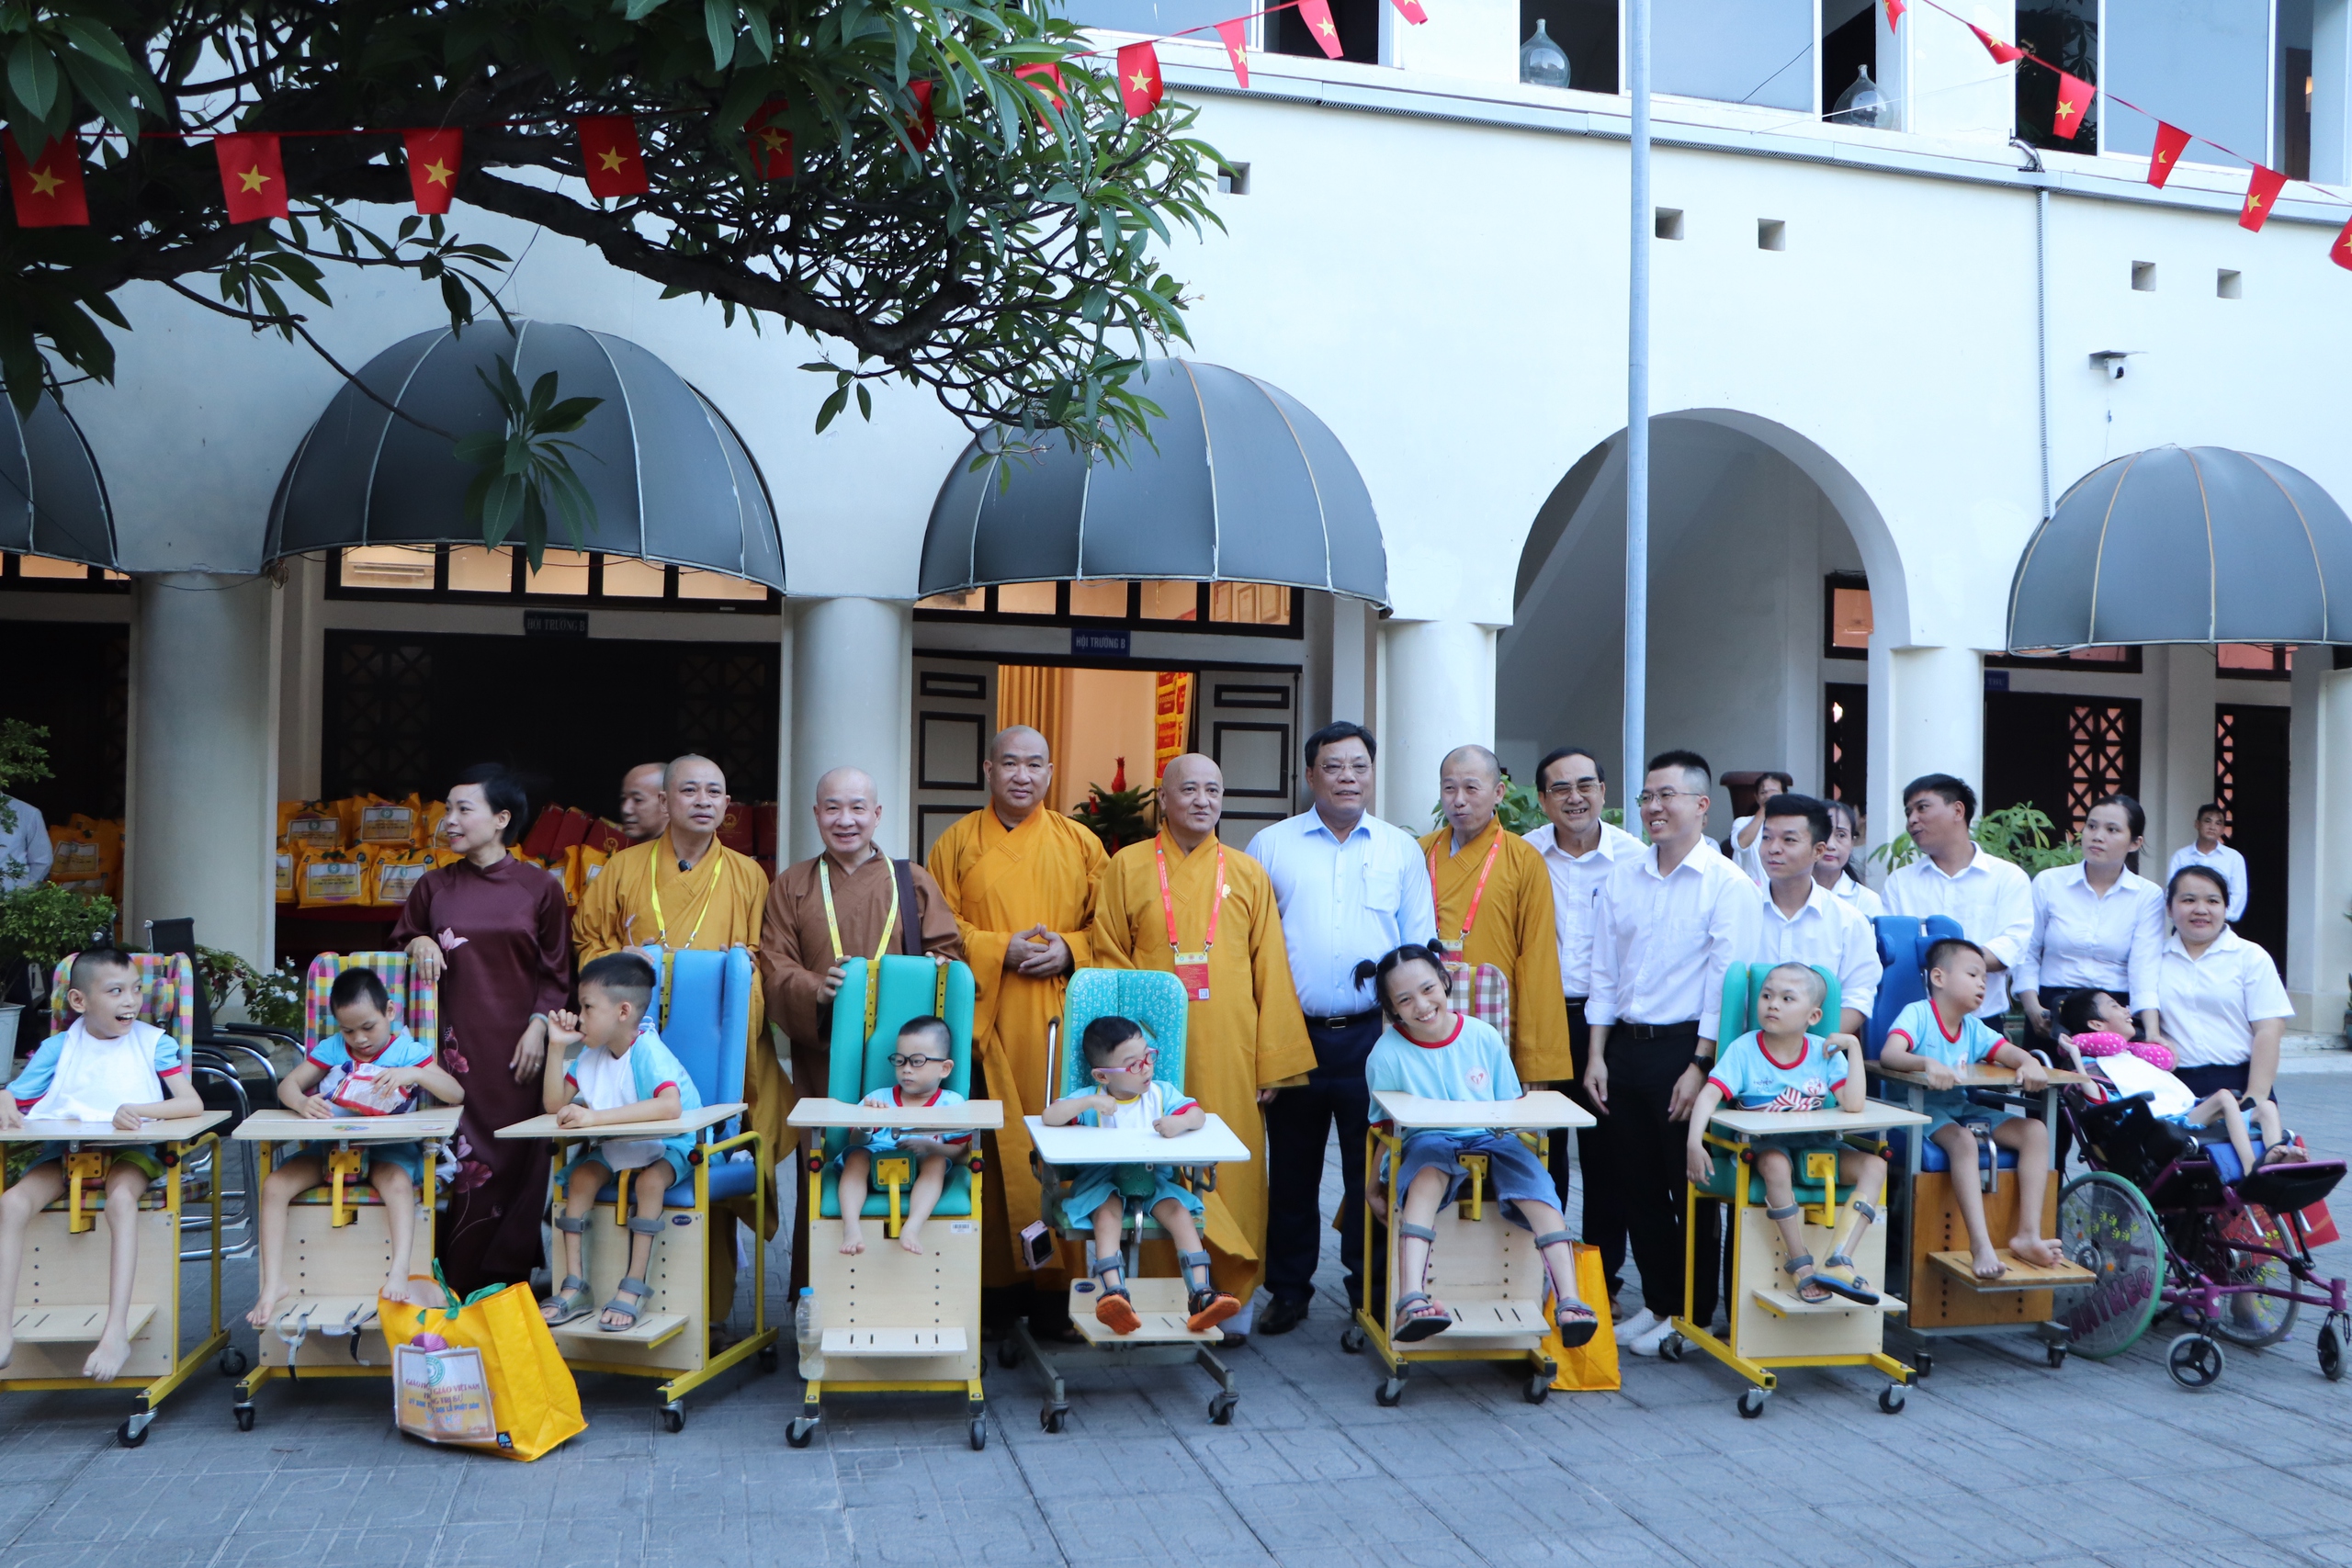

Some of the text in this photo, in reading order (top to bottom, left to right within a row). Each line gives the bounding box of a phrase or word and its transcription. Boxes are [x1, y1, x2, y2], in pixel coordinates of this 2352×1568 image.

[579, 620, 585, 632] B
[1076, 635, 1126, 649] HỘI TRƯỜNG B
[433, 1385, 452, 1395] GIÁO
[453, 1382, 468, 1393] VIỆT
